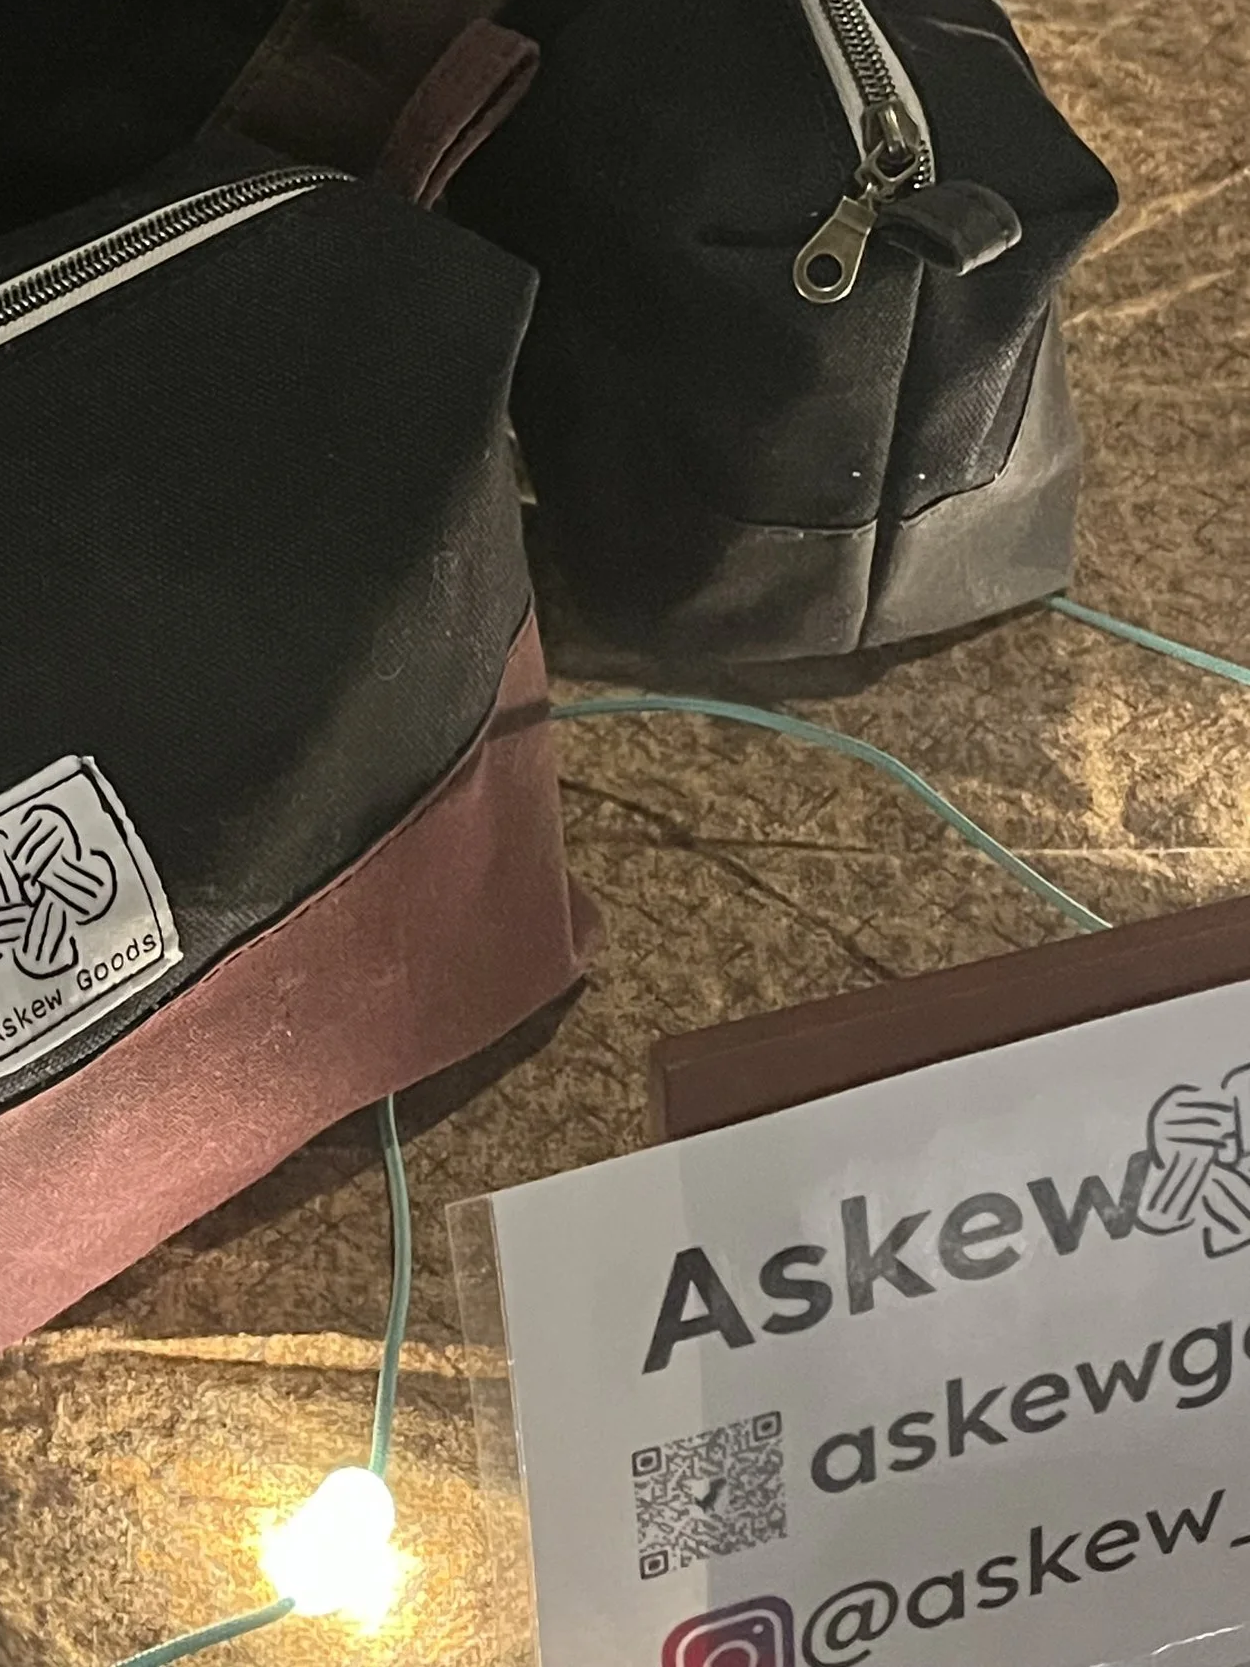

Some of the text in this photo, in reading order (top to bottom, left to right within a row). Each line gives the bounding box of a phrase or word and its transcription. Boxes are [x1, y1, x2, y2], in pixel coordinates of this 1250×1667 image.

[76, 934, 156, 991] Goods
[641, 1149, 1152, 1375] Askew
[810, 1319, 1250, 1494] askewg
